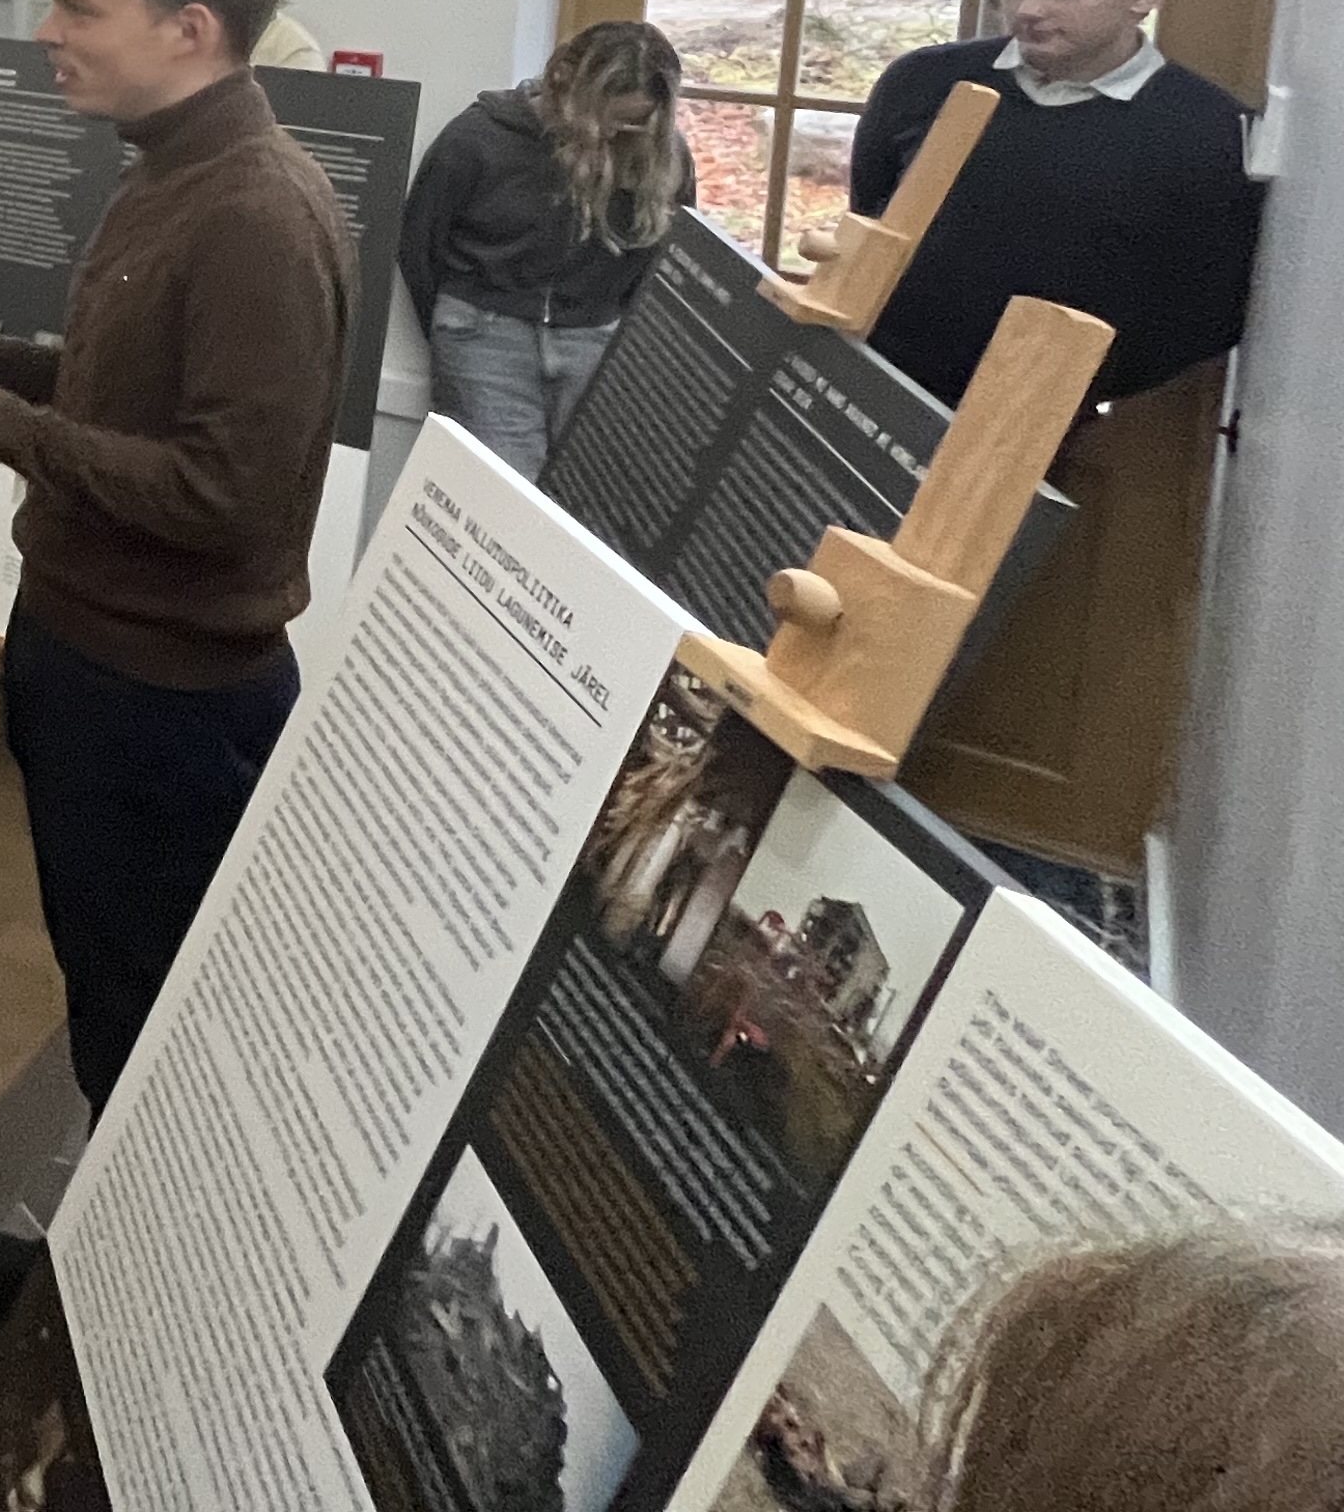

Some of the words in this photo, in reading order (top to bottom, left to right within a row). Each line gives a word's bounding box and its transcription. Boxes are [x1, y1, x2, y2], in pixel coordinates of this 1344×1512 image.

[423, 478, 461, 523] VENEMAA
[464, 515, 574, 630] VALLUTUSPOLIITIKA
[462, 552, 495, 593] LIIDU
[496, 588, 568, 666] LAGUNEMISE
[570, 663, 610, 712] JÄREL
